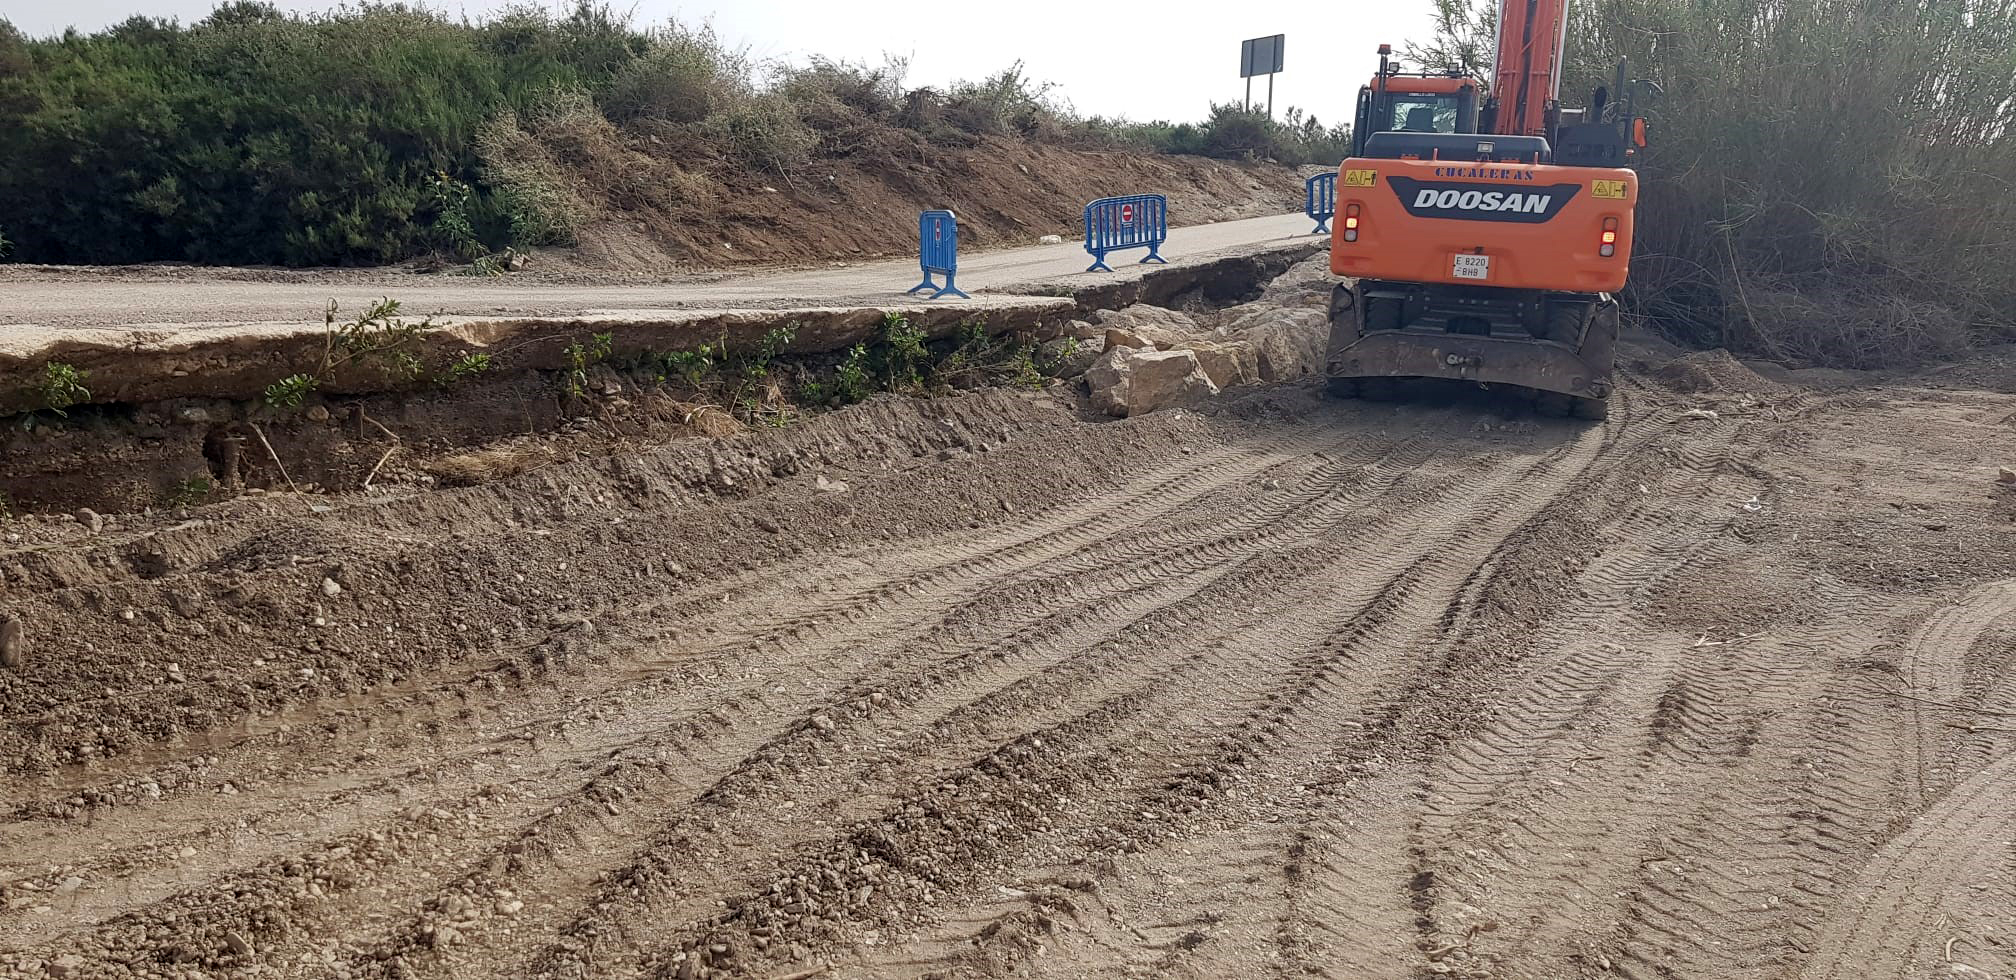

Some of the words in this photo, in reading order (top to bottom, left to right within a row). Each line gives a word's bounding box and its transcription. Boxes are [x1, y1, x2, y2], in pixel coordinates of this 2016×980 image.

[1435, 167, 1533, 180] CUCALERAS
[1413, 189, 1551, 214] DOOSAN
[1456, 257, 1462, 265] E
[1465, 257, 1486, 266] 8220
